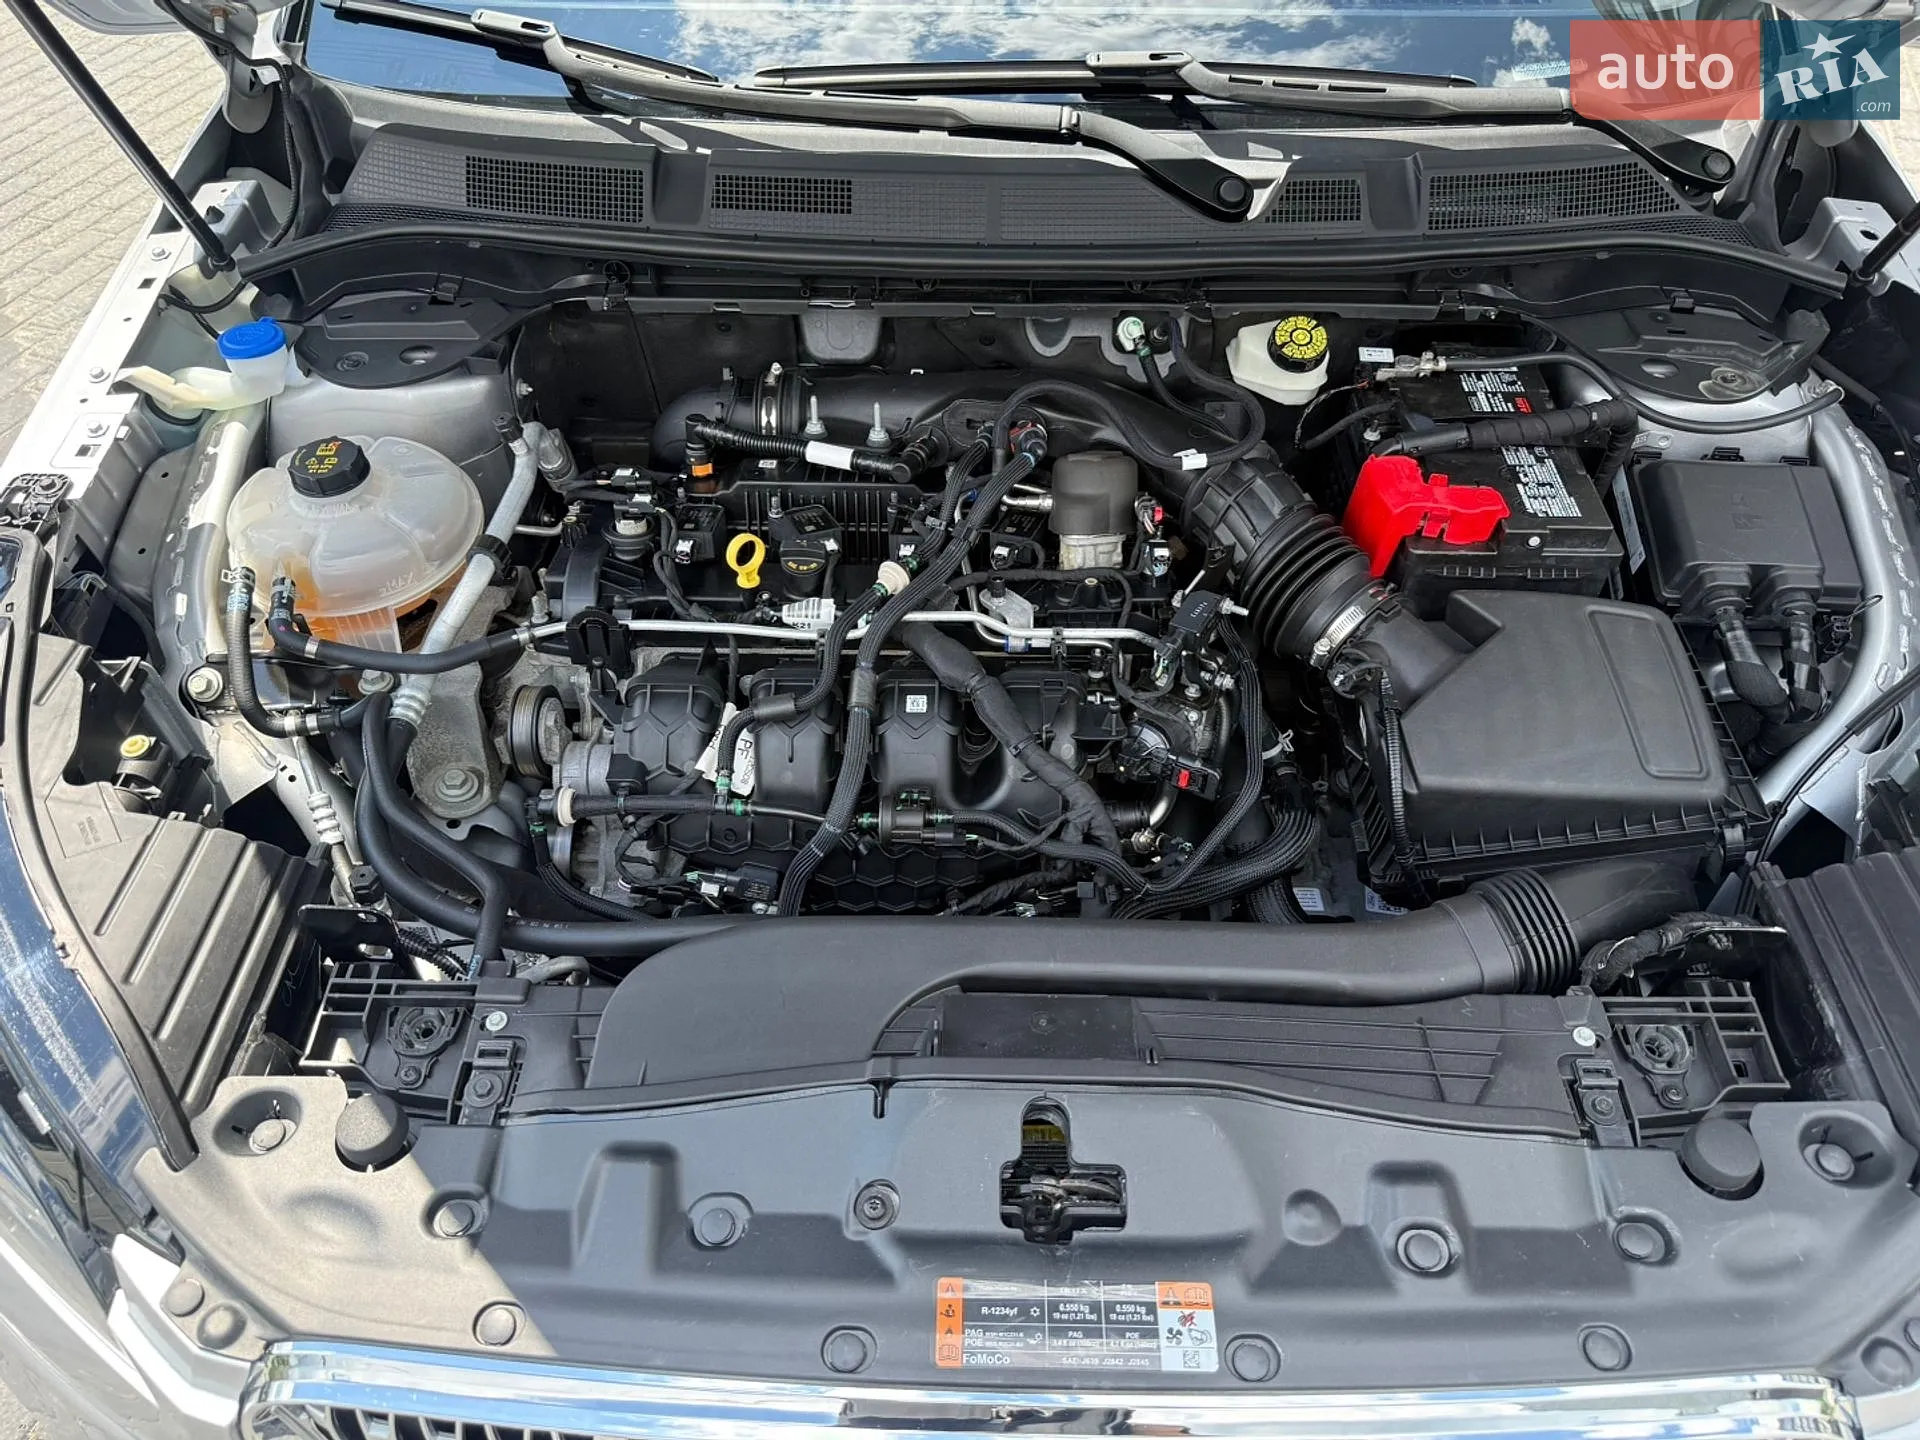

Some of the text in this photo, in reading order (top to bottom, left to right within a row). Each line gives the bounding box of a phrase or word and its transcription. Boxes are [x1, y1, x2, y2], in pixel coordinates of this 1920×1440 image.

[981, 1306, 1019, 1318] R-1234yf
[965, 1328, 984, 1337] PAG
[965, 1338, 984, 1347] POE
[963, 1353, 1010, 1365] FoMoCo
